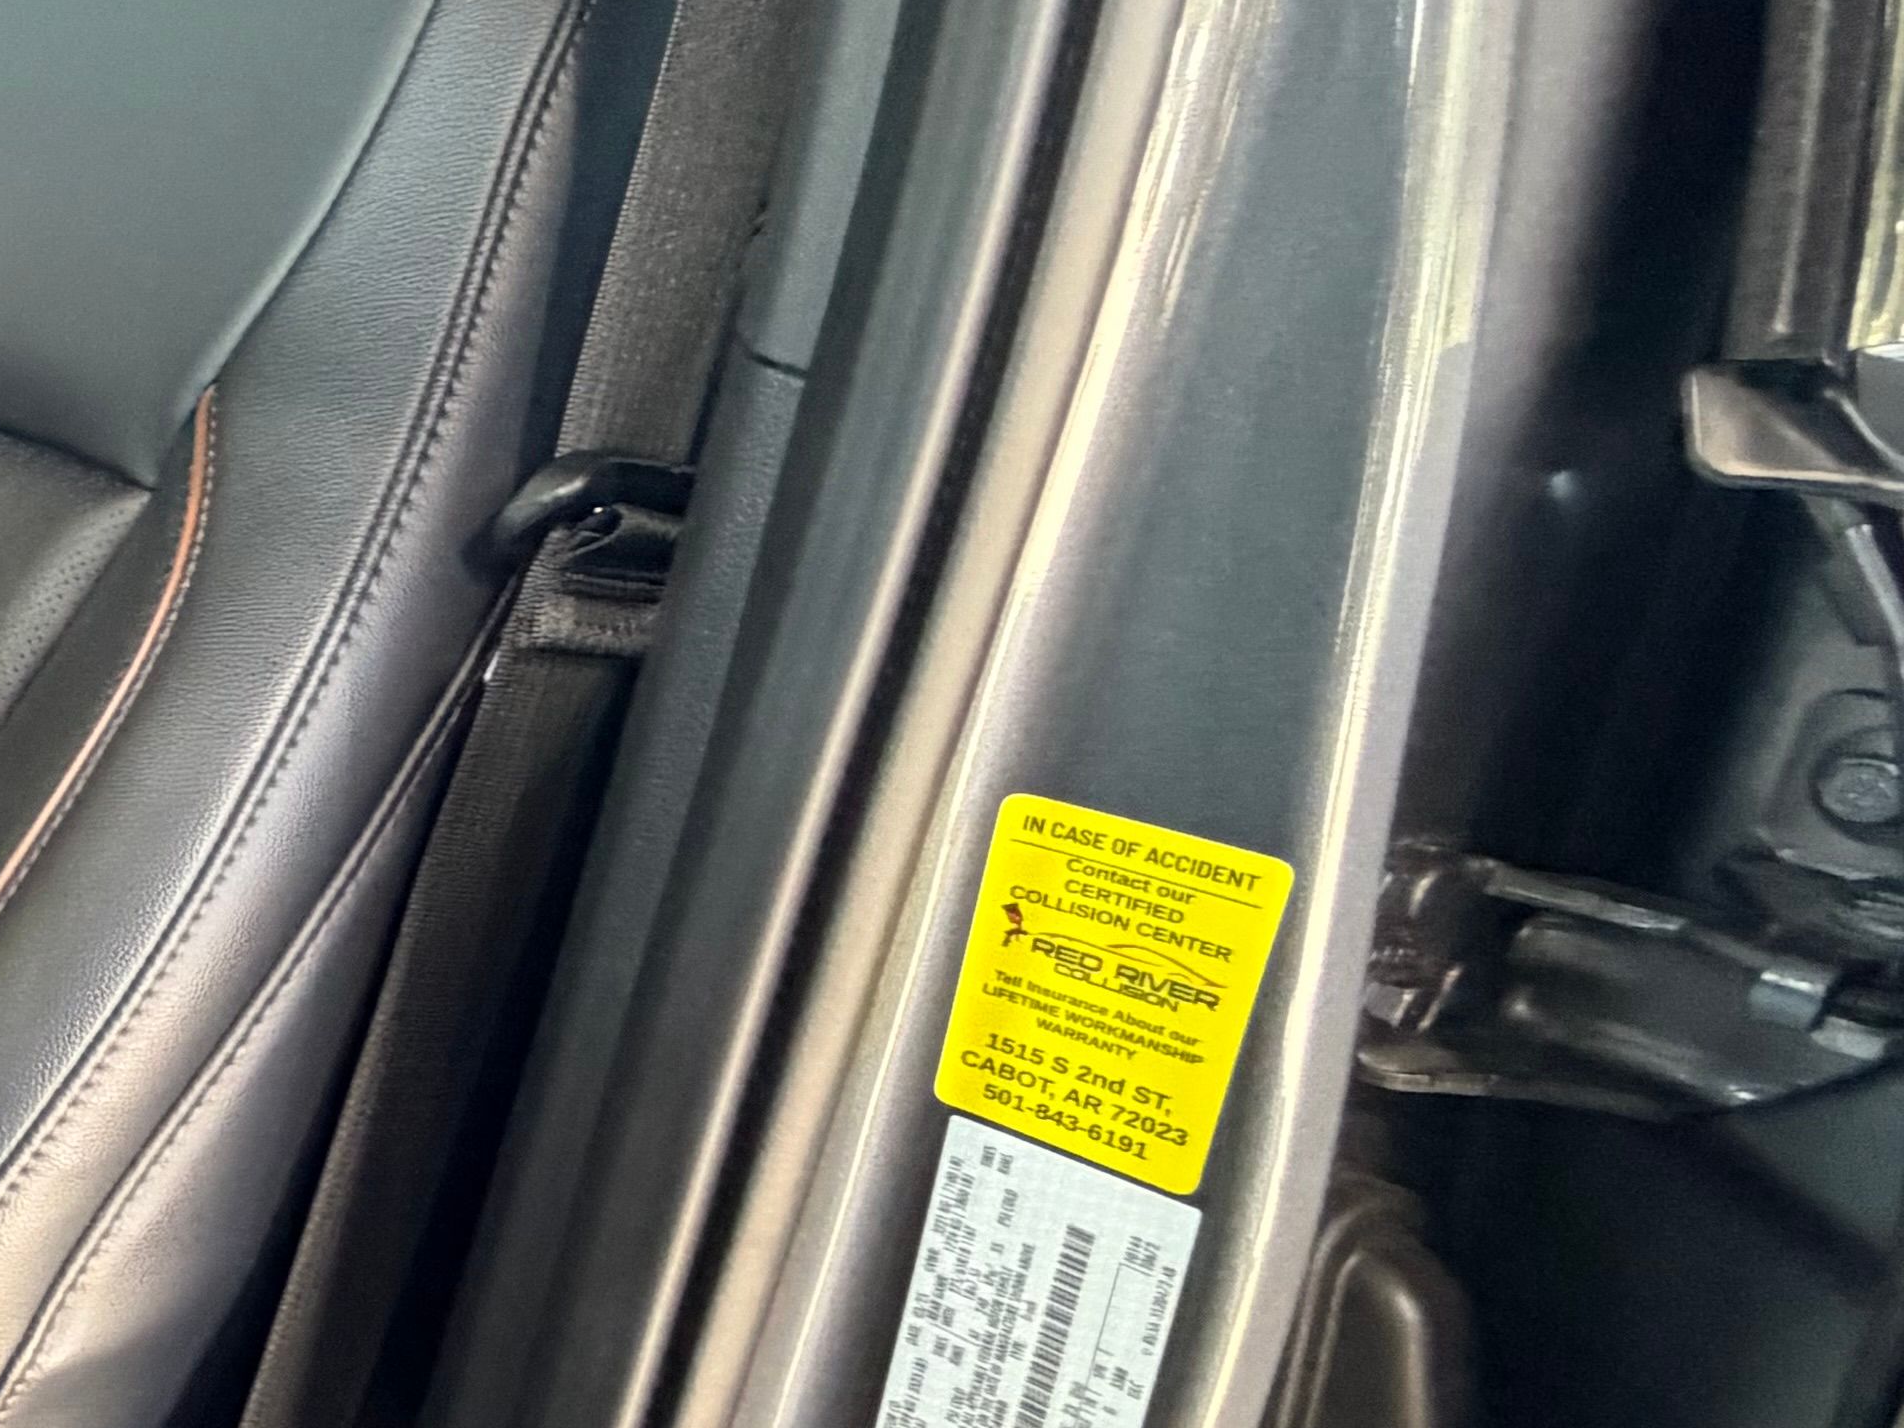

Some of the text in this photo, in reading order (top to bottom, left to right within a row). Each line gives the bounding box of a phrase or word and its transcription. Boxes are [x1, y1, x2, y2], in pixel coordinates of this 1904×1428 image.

[1023, 815, 1263, 892] IN CASE OF ACCIDENT
[1066, 859, 1196, 905] Contact our
[1009, 885, 1233, 962] COLLISION CENTER
[1064, 879, 1185, 924] CERTIFIED
[995, 970, 1201, 1047] Tell Insurance About our
[1031, 938, 1220, 1012] RED RIVER
[1053, 963, 1179, 1013] COLLISION
[982, 983, 1205, 1065] LIFETIME WORKMANSHIP
[1036, 1018, 1137, 1061] WARRANTY
[960, 1050, 1190, 1147] CABOT, AR 72023
[985, 1033, 1173, 1117] 1515 S 2nd ST,
[983, 1083, 1149, 1161] 501-843-6191
